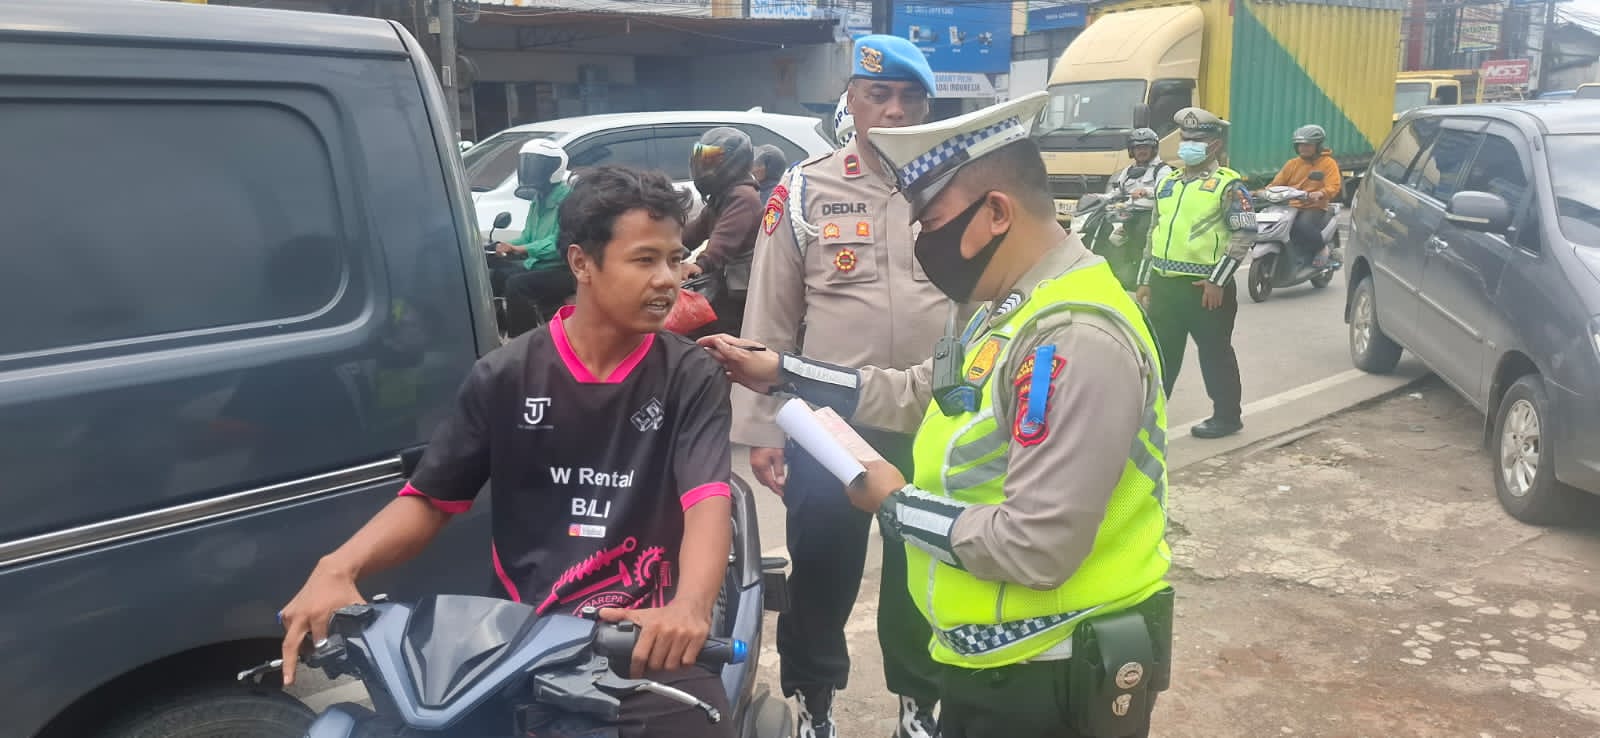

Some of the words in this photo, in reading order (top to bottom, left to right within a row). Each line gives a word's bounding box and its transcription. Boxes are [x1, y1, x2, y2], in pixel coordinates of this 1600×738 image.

[752, 0, 809, 17] SHOWCASE
[550, 466, 572, 485] W
[579, 467, 635, 488] Rental
